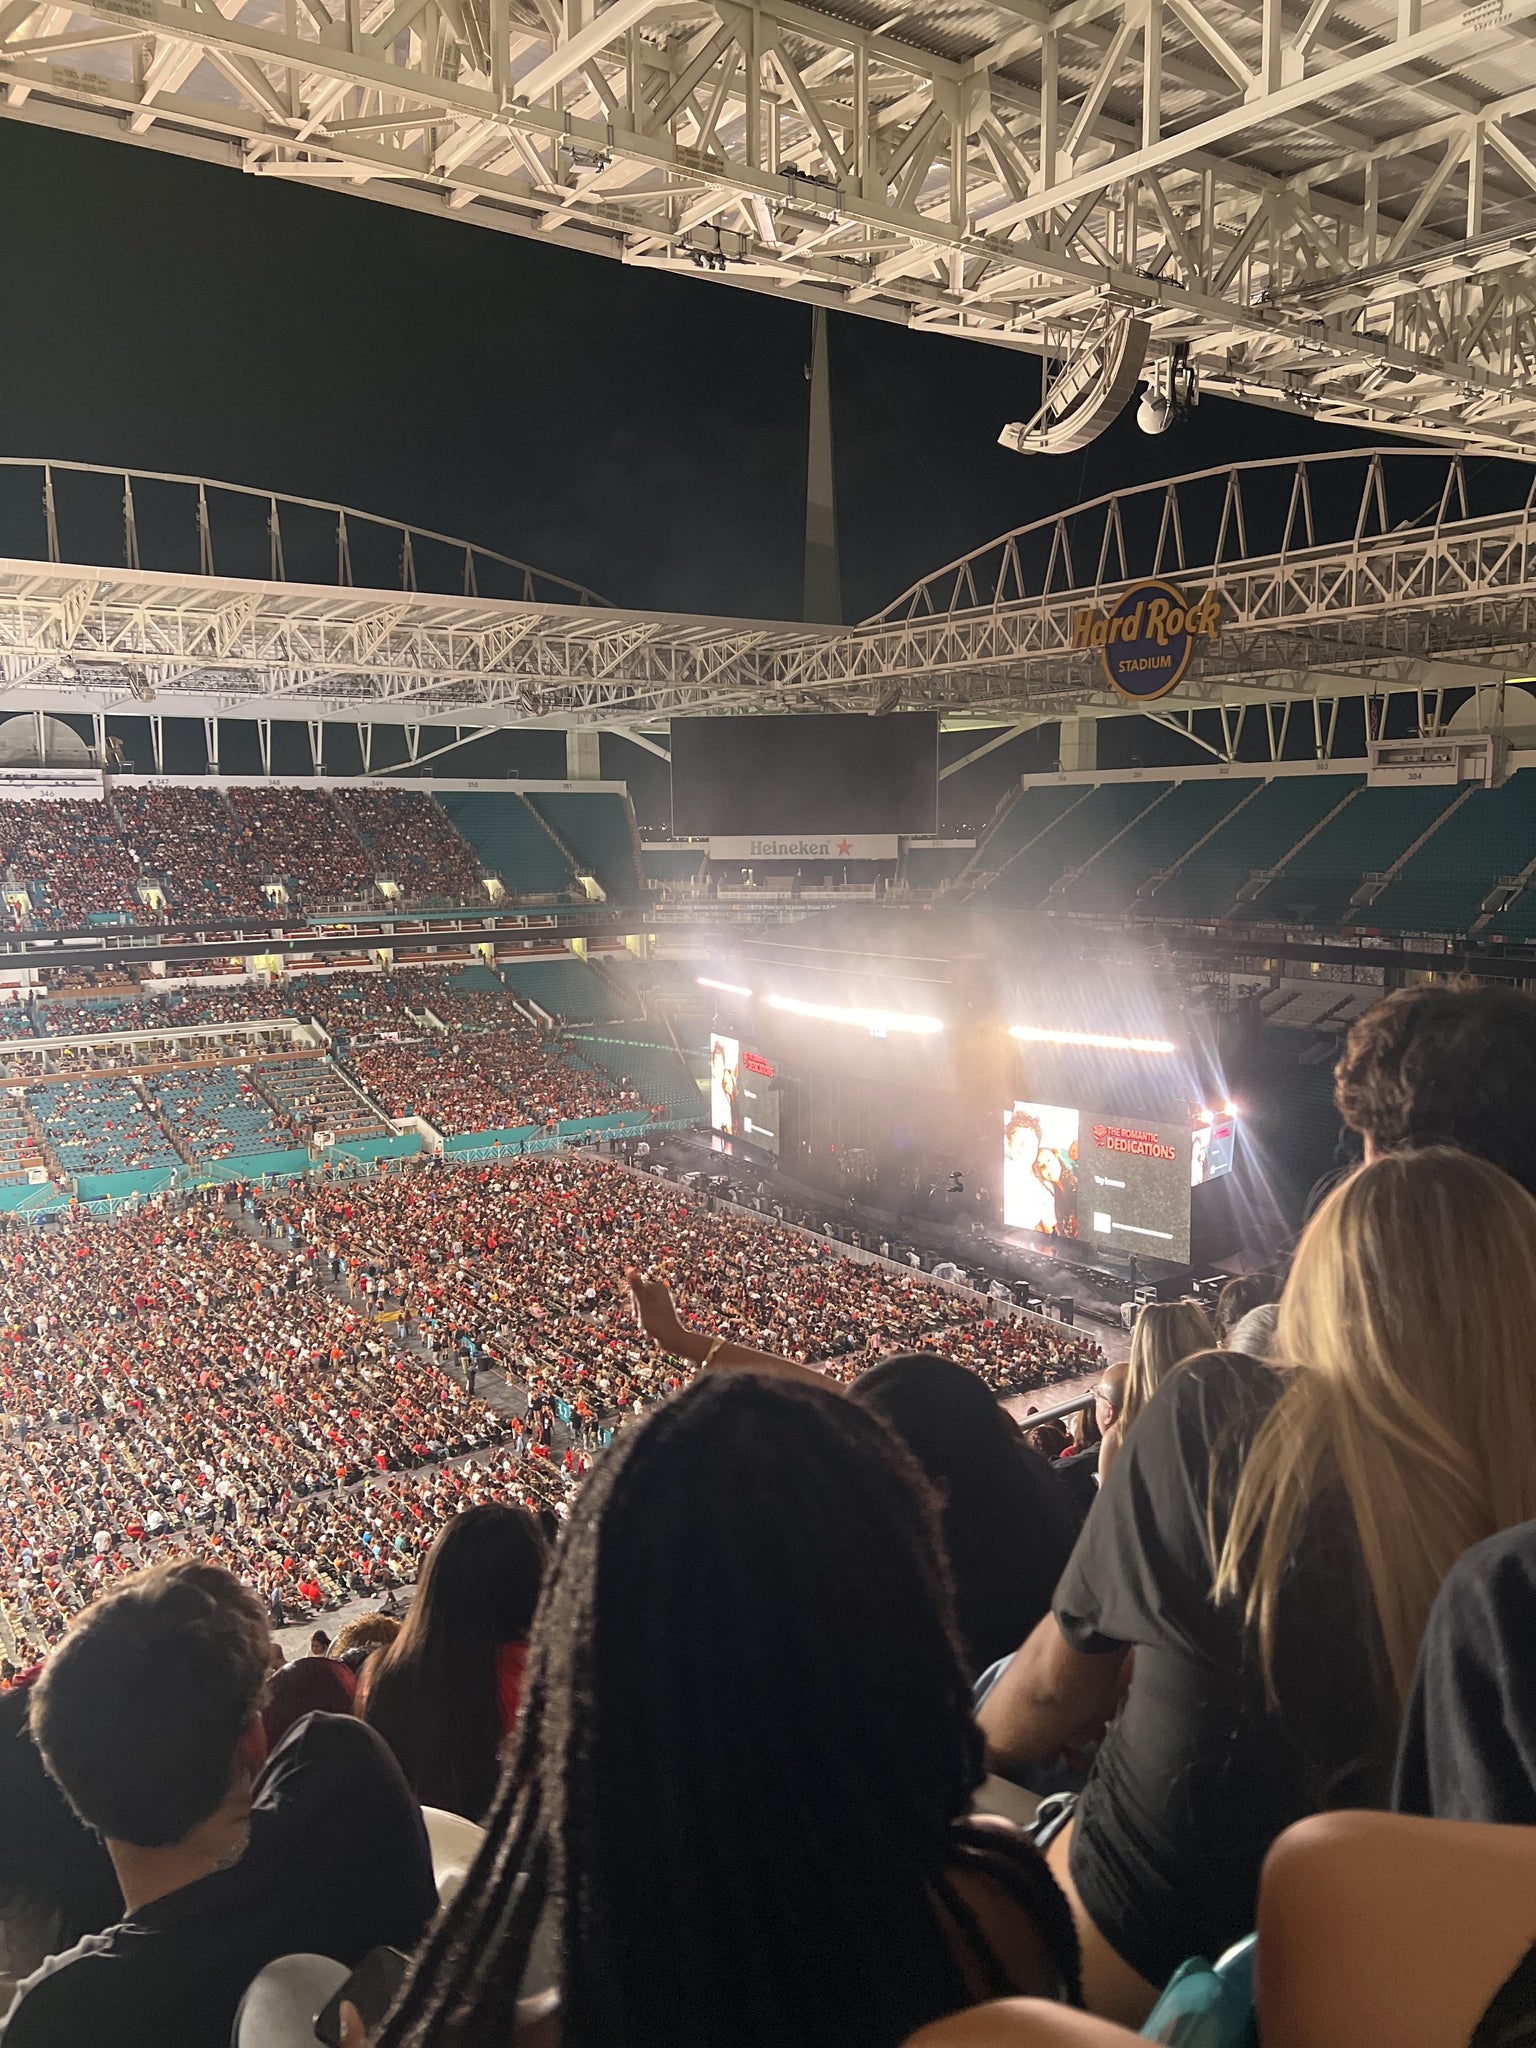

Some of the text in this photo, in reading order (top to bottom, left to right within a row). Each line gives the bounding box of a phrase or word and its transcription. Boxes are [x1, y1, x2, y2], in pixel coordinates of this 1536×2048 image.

[1071, 590, 1222, 649] Hard Rock
[1119, 655, 1172, 673] STADIUM
[750, 840, 830, 855] Heineken
[1400, 930, 1420, 938] ZACH
[1422, 931, 1454, 940] THOMAS
[1107, 1126, 1159, 1142] THE ROMANTIC
[1106, 1136, 1177, 1160] DEDICATIONS
